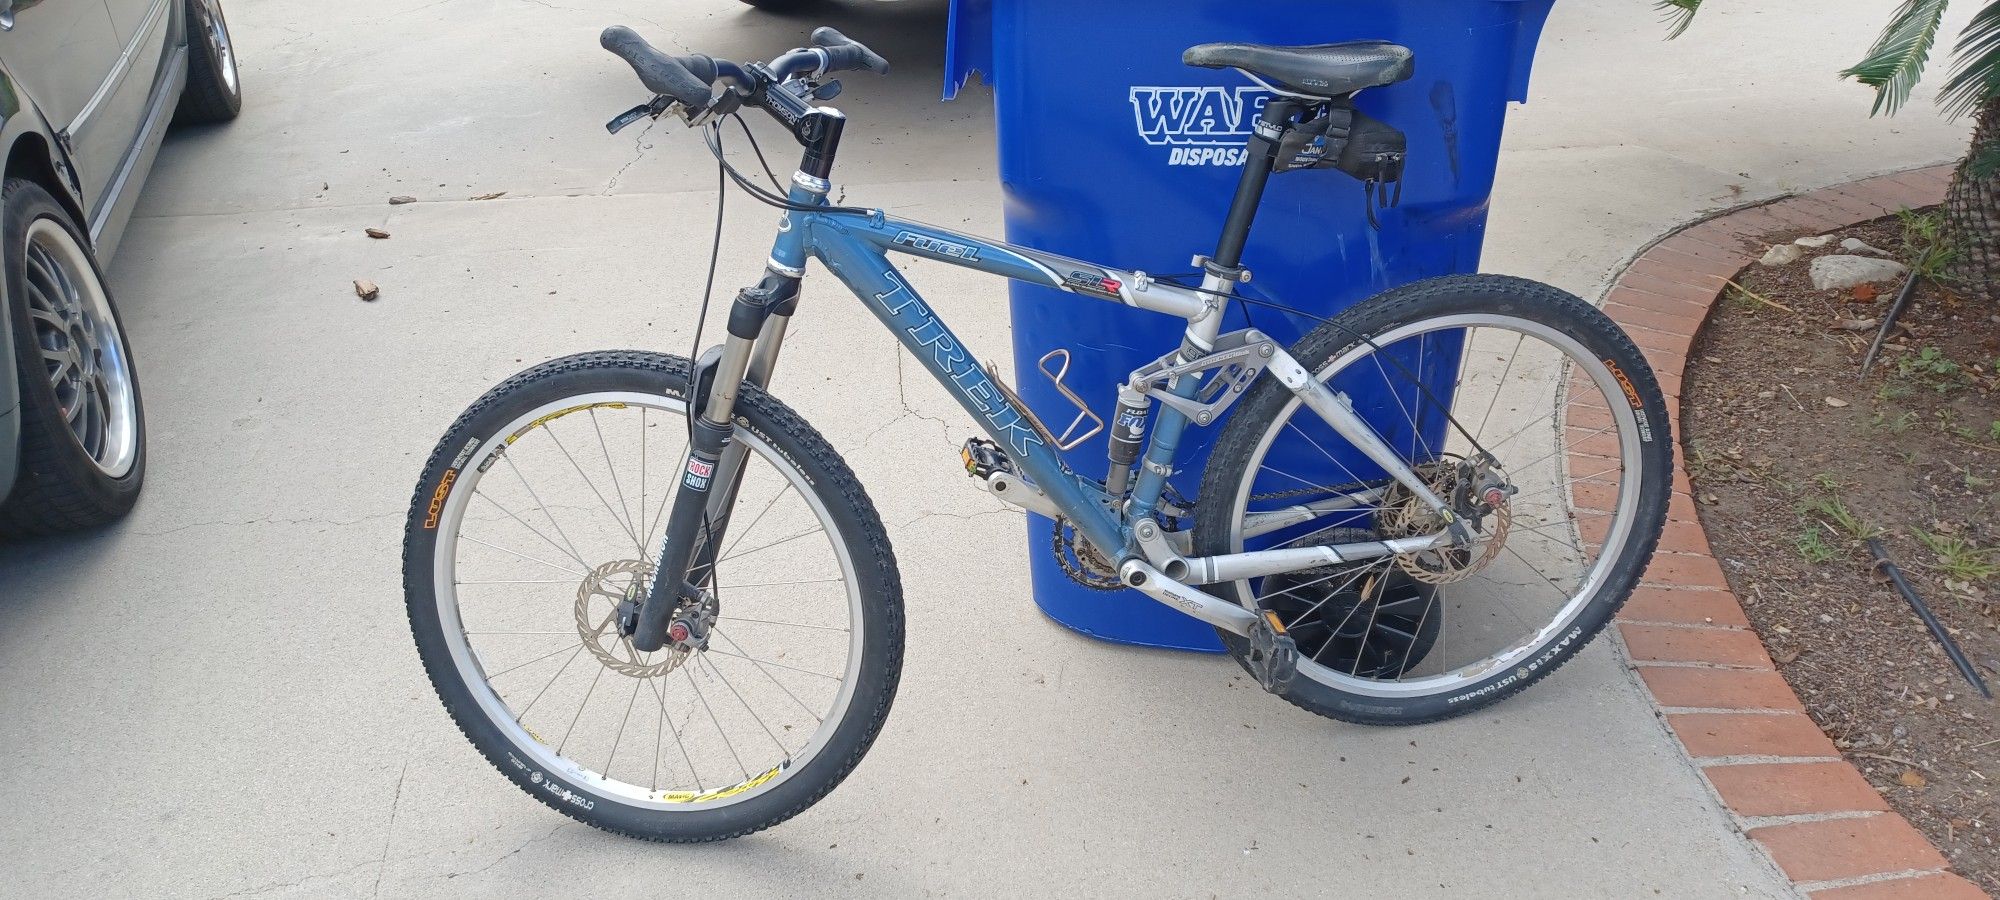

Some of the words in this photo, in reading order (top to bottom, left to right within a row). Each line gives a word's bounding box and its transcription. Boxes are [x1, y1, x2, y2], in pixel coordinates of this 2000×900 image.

[765, 96, 799, 123] THOMSON
[1168, 147, 1249, 166] DISPOSA
[1301, 143, 1323, 154] JAN
[892, 231, 980, 262] FUEL
[1069, 270, 1122, 293] SLR
[875, 270, 1044, 457] TREK
[1603, 359, 1643, 408] LUST
[1117, 412, 1147, 428] FO
[751, 425, 773, 443] UST
[773, 442, 815, 486] tubeless
[688, 460, 712, 477] ROCK
[685, 473, 708, 489] SHOX
[423, 469, 456, 528] LUST
[1448, 683, 1496, 704] tubeless
[1497, 675, 1517, 690] UST
